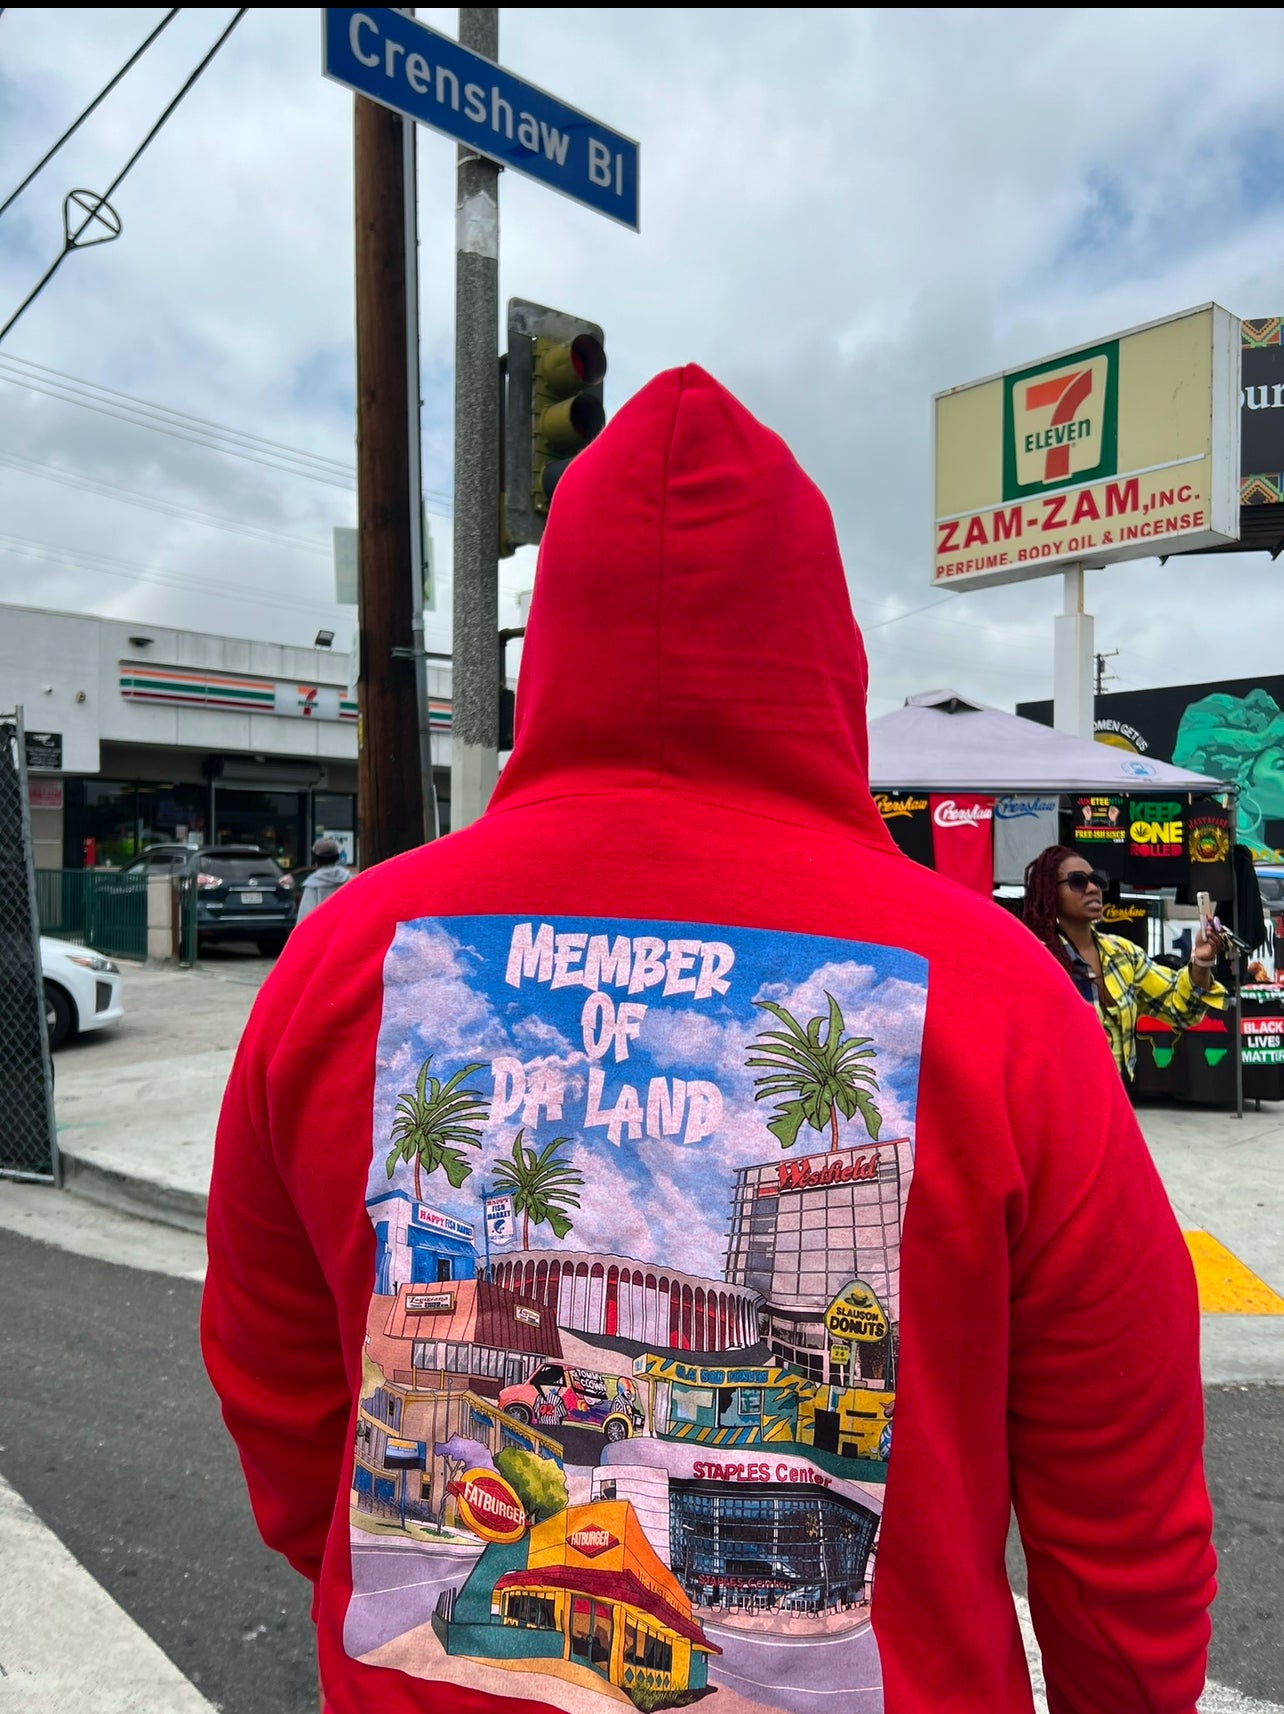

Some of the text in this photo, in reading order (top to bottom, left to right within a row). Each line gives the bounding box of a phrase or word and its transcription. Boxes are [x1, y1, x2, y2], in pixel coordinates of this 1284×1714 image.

[350, 13, 623, 197] Crenshaw Bl
[1025, 368, 1092, 481] 7
[1017, 541, 1063, 563] BODY
[1067, 533, 1096, 553] OIL
[1102, 530, 1113, 545] &
[1119, 510, 1204, 541] INCENSE
[1120, 723, 1139, 742] GET
[1135, 735, 1149, 752] US
[933, 799, 993, 828] Crenshaw
[994, 794, 1056, 822] Crenshaw
[1129, 801, 1182, 821] KEEP
[1129, 820, 1183, 844] ONE
[1129, 844, 1183, 857] ROLLED
[1101, 902, 1147, 923] Crenshaw
[504, 922, 736, 1000] MEMBER
[580, 991, 649, 1064] OF
[1243, 1021, 1284, 1035] BLACK
[1247, 1035, 1281, 1049] LIVES
[489, 1056, 725, 1148] DA LAND
[775, 1152, 882, 1190] Westfield
[419, 1209, 445, 1226] HAPPY
[488, 1210, 511, 1220] MARKET
[829, 1315, 885, 1337] DONUTS
[836, 1306, 879, 1322] SLAUSON
[693, 1460, 833, 1488] STAPLES Center
[463, 1481, 527, 1526] FATBURGER
[570, 1530, 610, 1547] FATBURGER
[698, 1574, 744, 1588] STAPLES
